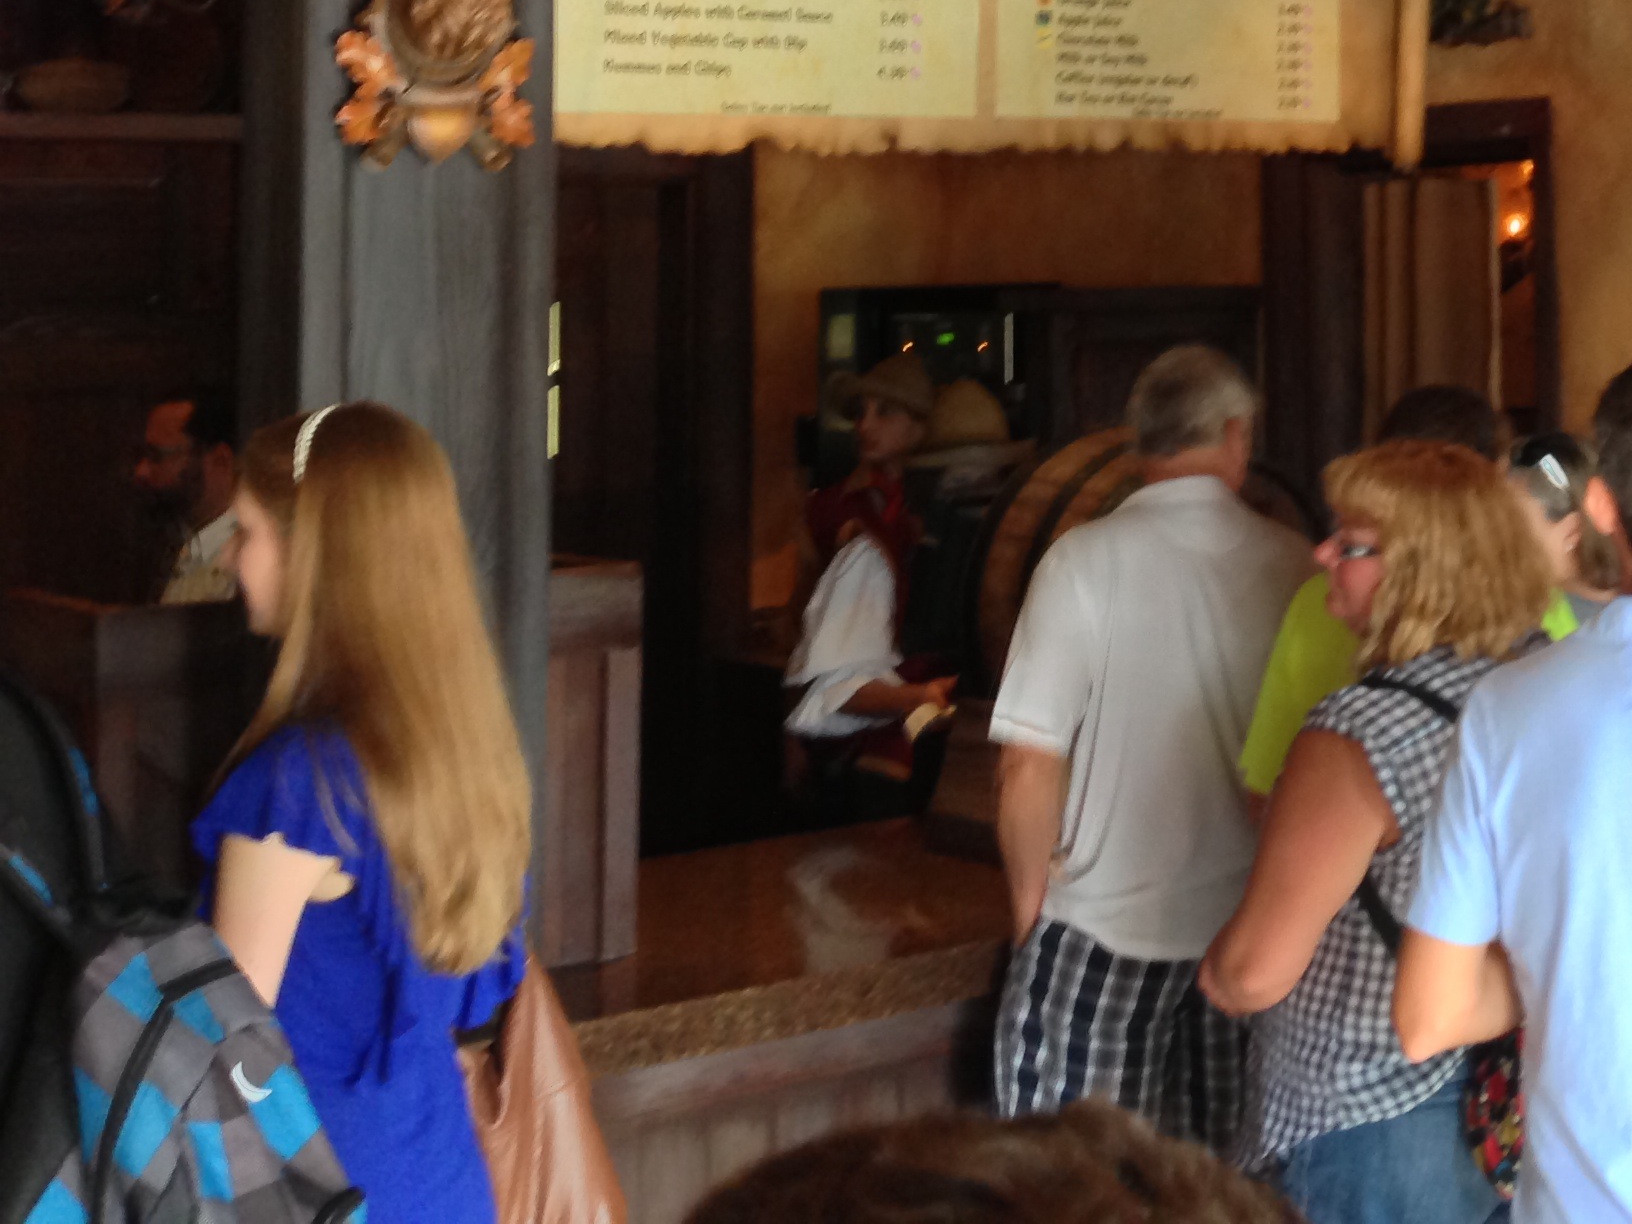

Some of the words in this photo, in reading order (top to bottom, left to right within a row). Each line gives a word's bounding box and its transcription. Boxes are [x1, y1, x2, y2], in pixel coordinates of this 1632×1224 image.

[654, 2, 701, 22] Apples
[704, 4, 735, 20] with
[737, 5, 792, 23] Caramel
[652, 30, 719, 50] Vegetable
[722, 32, 748, 52] Cup
[752, 34, 780, 50] with
[665, 60, 692, 75] and
